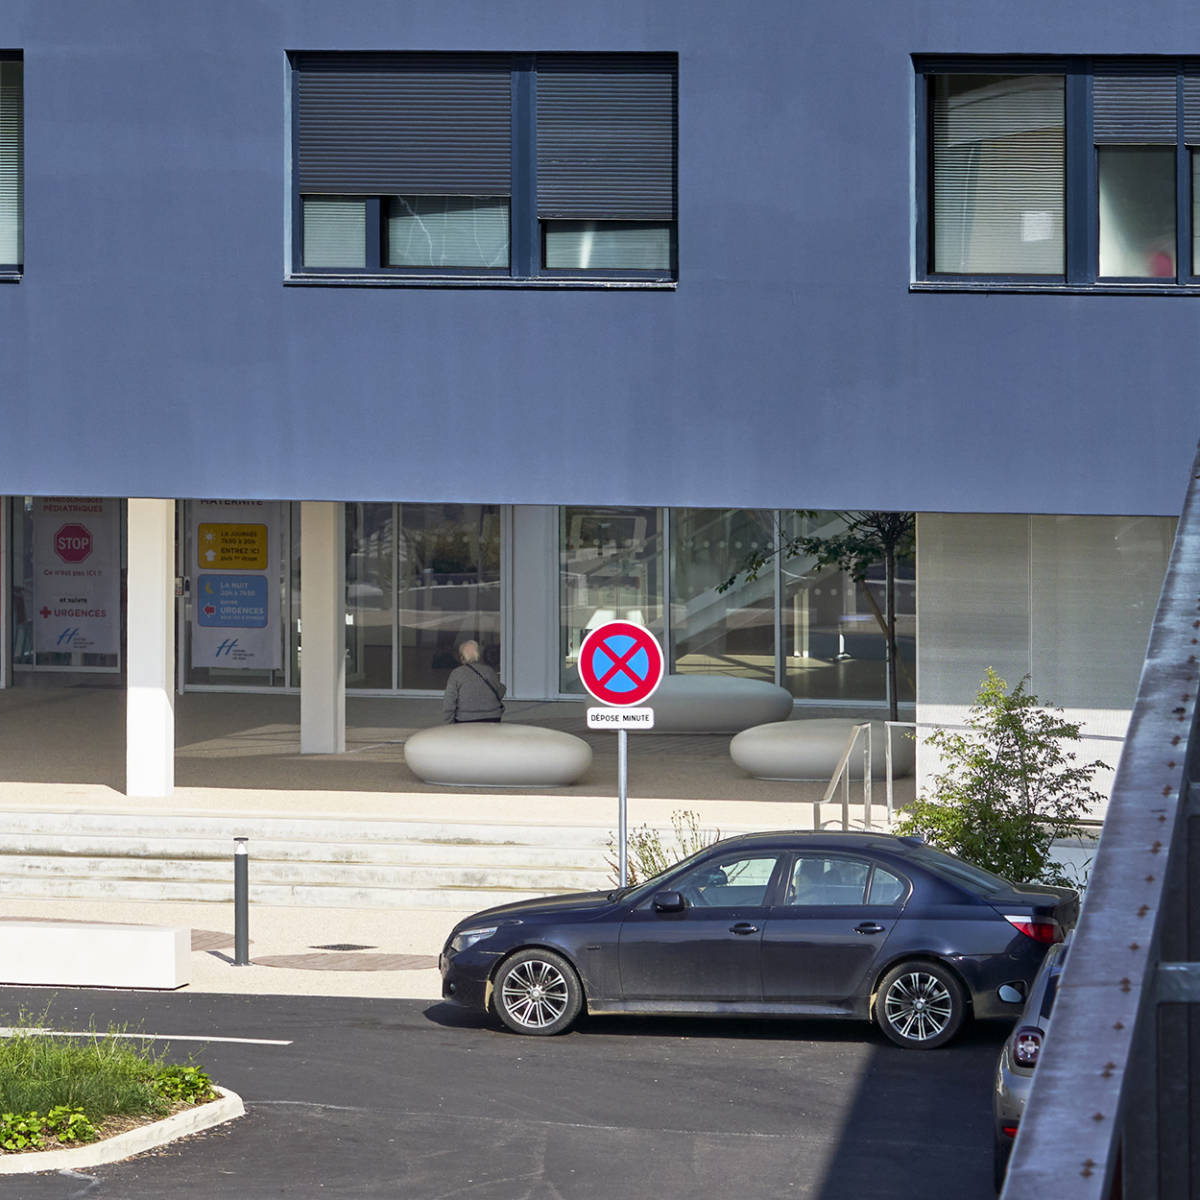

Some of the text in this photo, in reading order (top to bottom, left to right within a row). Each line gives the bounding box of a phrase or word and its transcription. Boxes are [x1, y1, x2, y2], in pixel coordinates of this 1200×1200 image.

[58, 537, 89, 550] STOP
[53, 608, 107, 618] URGENCES
[220, 606, 265, 615] URGENCES
[590, 712, 650, 722] DÉPOSE MINUTE
